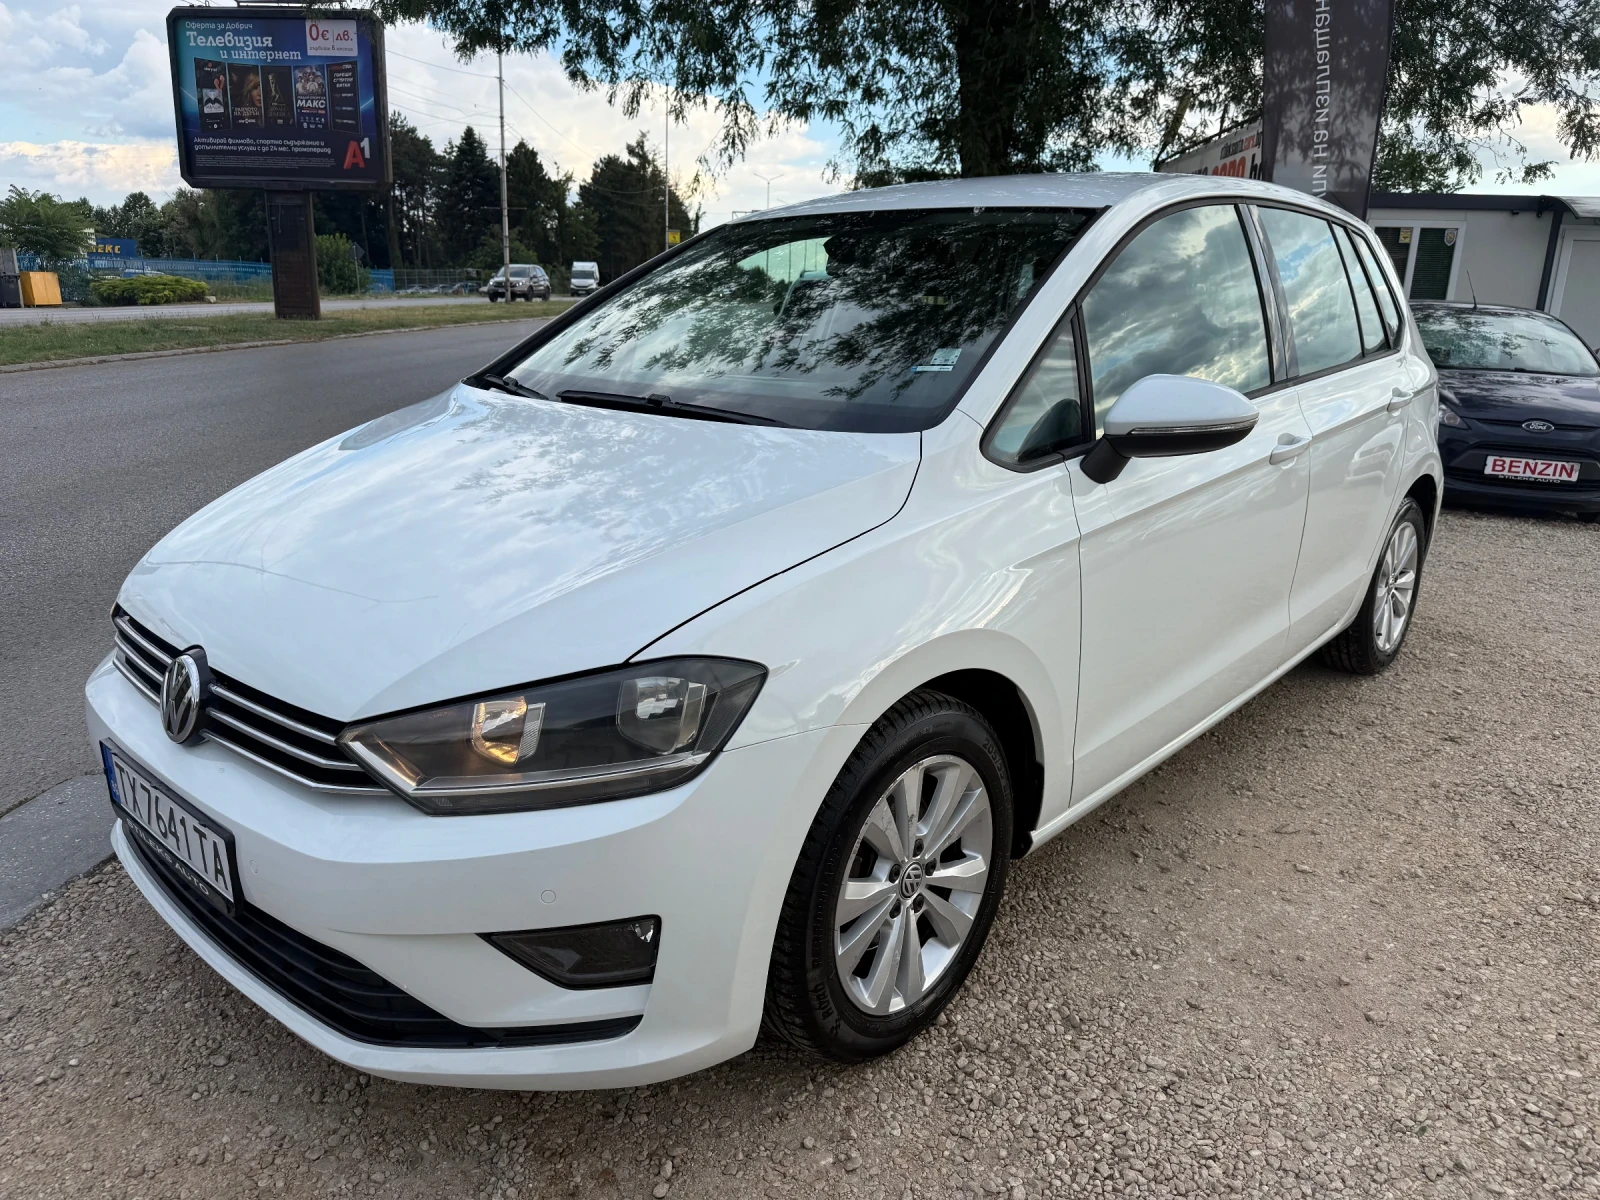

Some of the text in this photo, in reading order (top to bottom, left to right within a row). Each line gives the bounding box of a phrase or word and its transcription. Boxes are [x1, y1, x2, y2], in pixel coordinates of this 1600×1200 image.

[185, 21, 253, 30] Оферта за Добрич
[185, 31, 273, 50] Телевизия
[220, 50, 302, 62] и интернет
[297, 99, 326, 109] МАКС
[343, 137, 370, 170] A1
[1529, 422, 1547, 430] Ford
[1491, 458, 1575, 478] BENZIN
[126, 818, 210, 896] STILEKS AUTO
